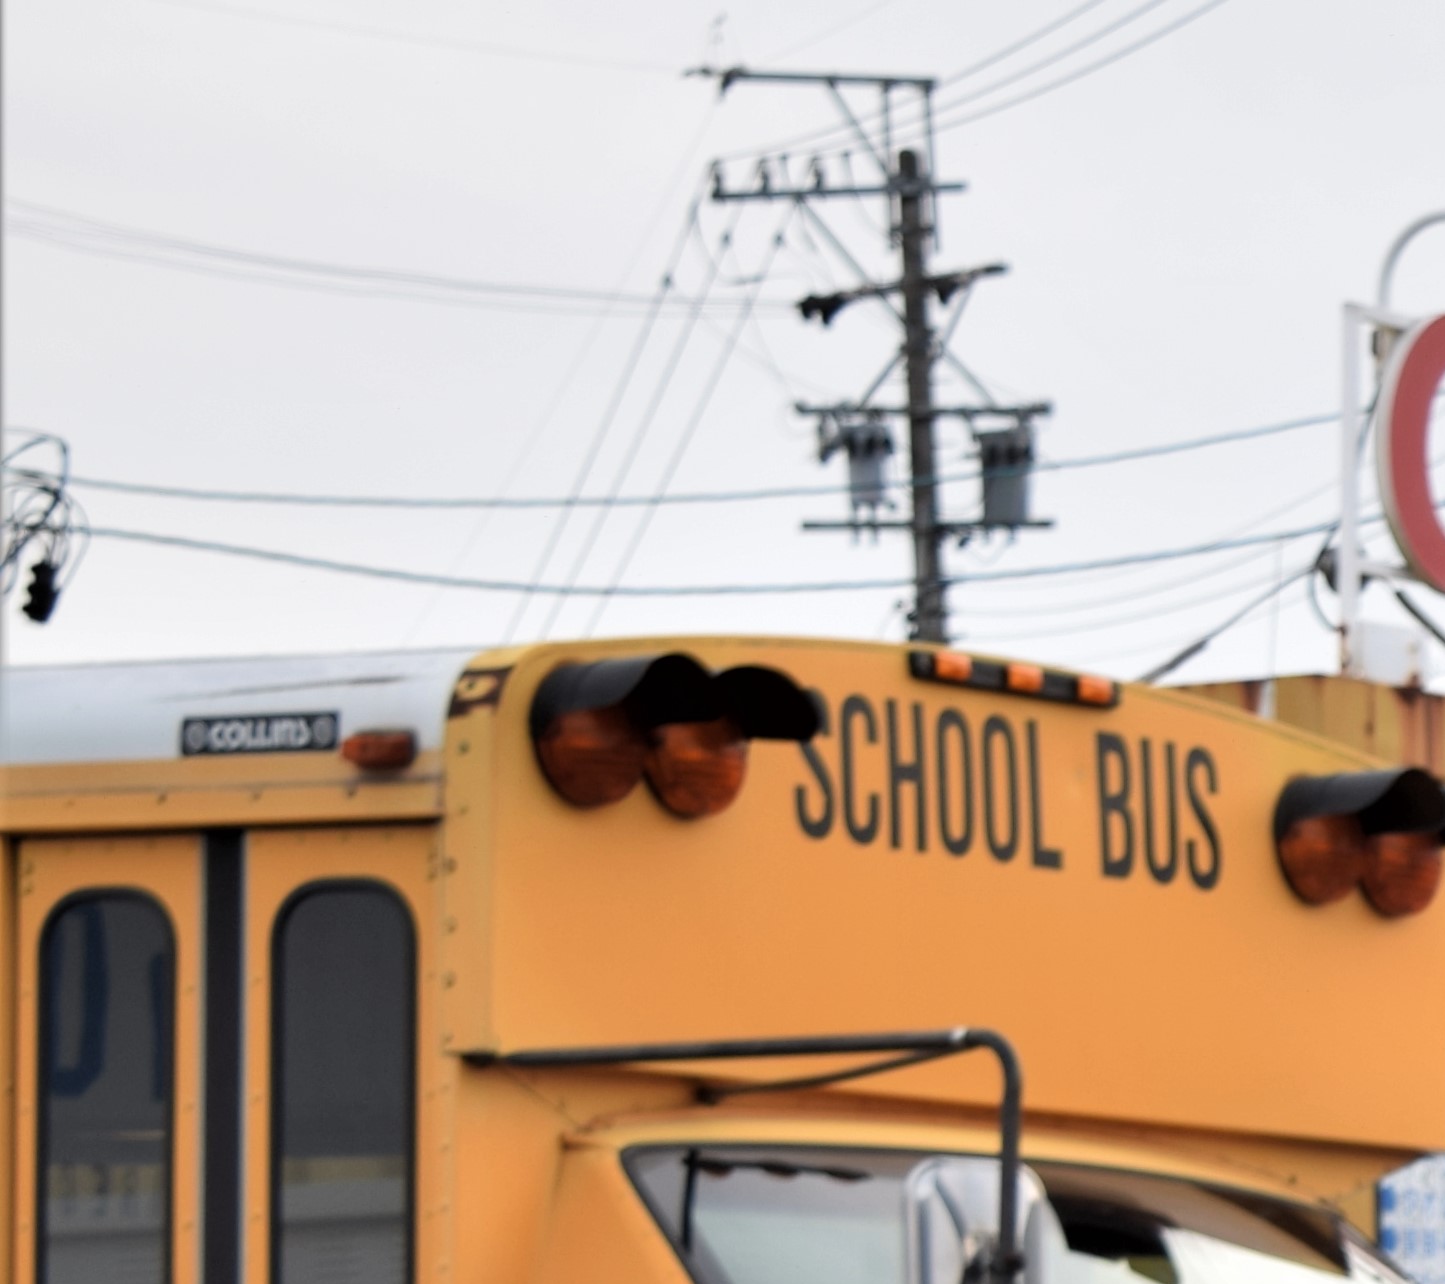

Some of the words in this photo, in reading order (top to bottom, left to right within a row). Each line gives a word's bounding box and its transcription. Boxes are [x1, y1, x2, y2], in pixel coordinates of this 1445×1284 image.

[209, 716, 313, 751] COLLINS
[795, 692, 1063, 871] SCHOOL
[1096, 731, 1223, 891] BUS
